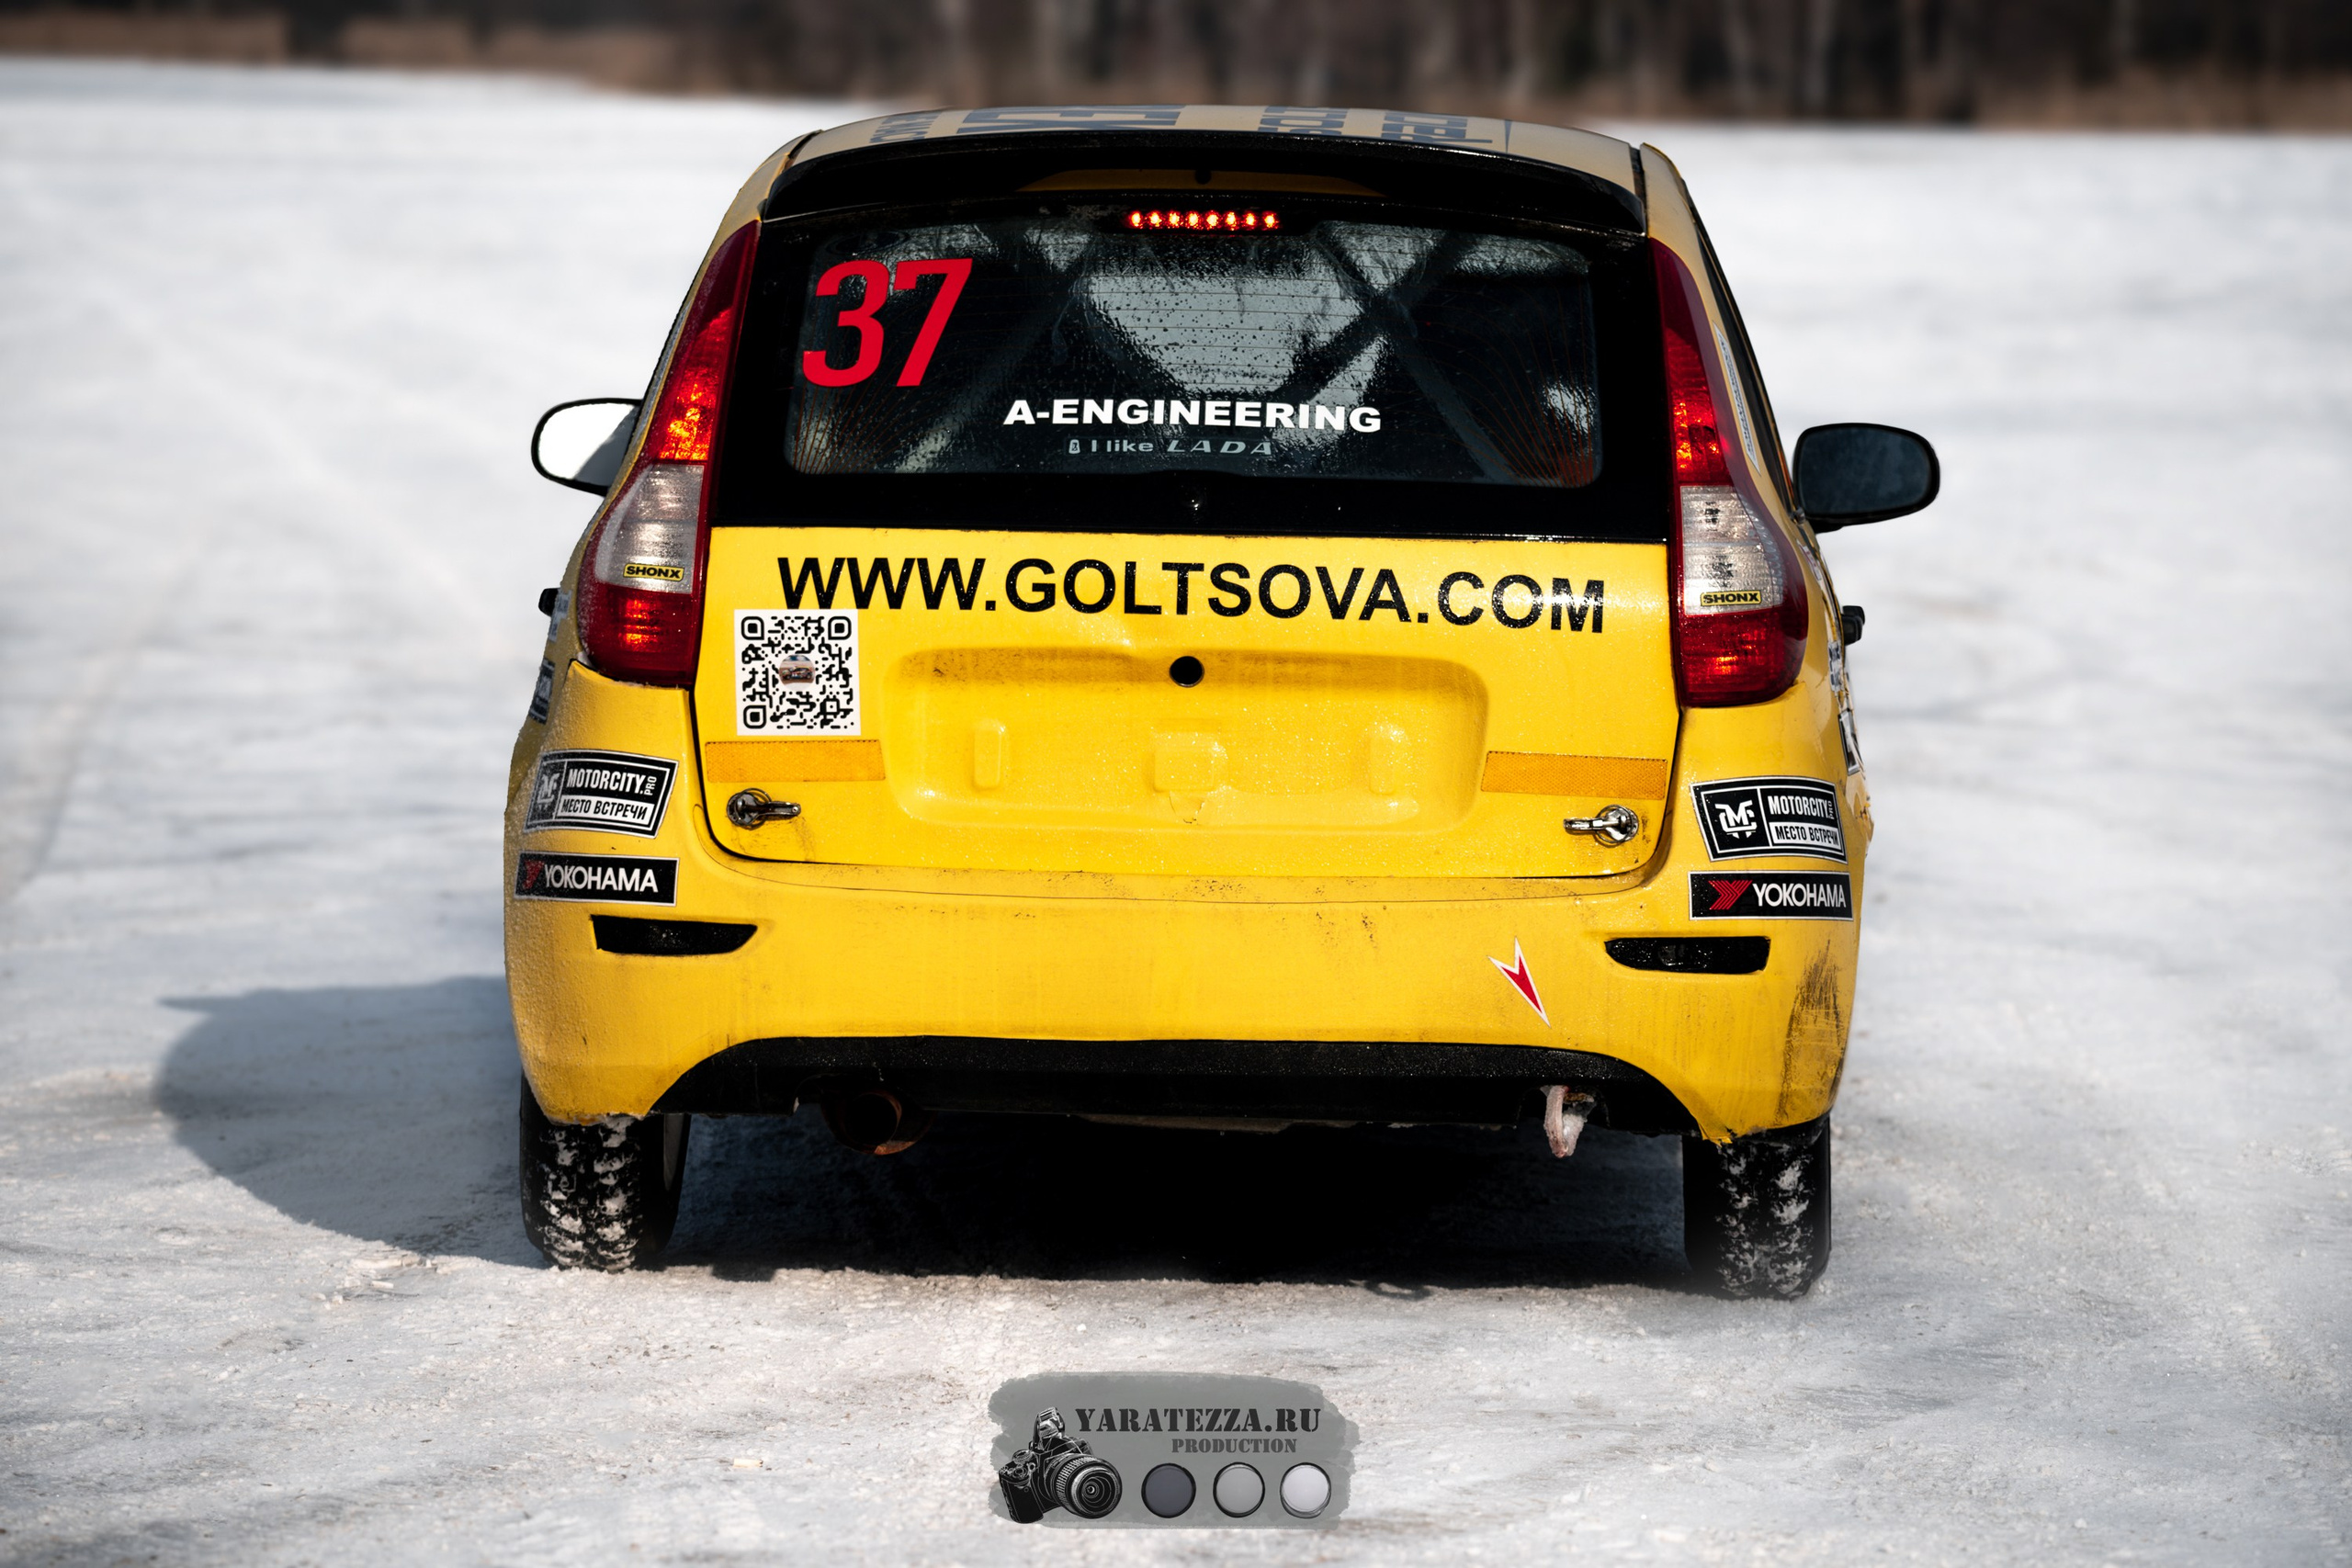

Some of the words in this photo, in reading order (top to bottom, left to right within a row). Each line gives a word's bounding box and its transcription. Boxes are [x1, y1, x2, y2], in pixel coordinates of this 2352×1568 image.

[802, 258, 972, 388] 37
[1003, 400, 1381, 433] A-ENGINEERING
[1106, 439, 1154, 452] like
[1167, 439, 1272, 455] LADA
[627, 566, 681, 579] SHONX
[777, 556, 1605, 634] WWW.GOLTSOVA.COM
[1703, 592, 1759, 604] SHONX
[644, 775, 657, 795] PRO
[561, 798, 591, 814] МЕСТО
[594, 800, 648, 820] ВСТРЕЧИ
[1774, 825, 1807, 840] МЕСТО
[1809, 826, 1838, 845] ВСТРЕЧИ
[544, 864, 658, 893] YOKOHAMA
[1752, 884, 1846, 908] YOKOHAMA
